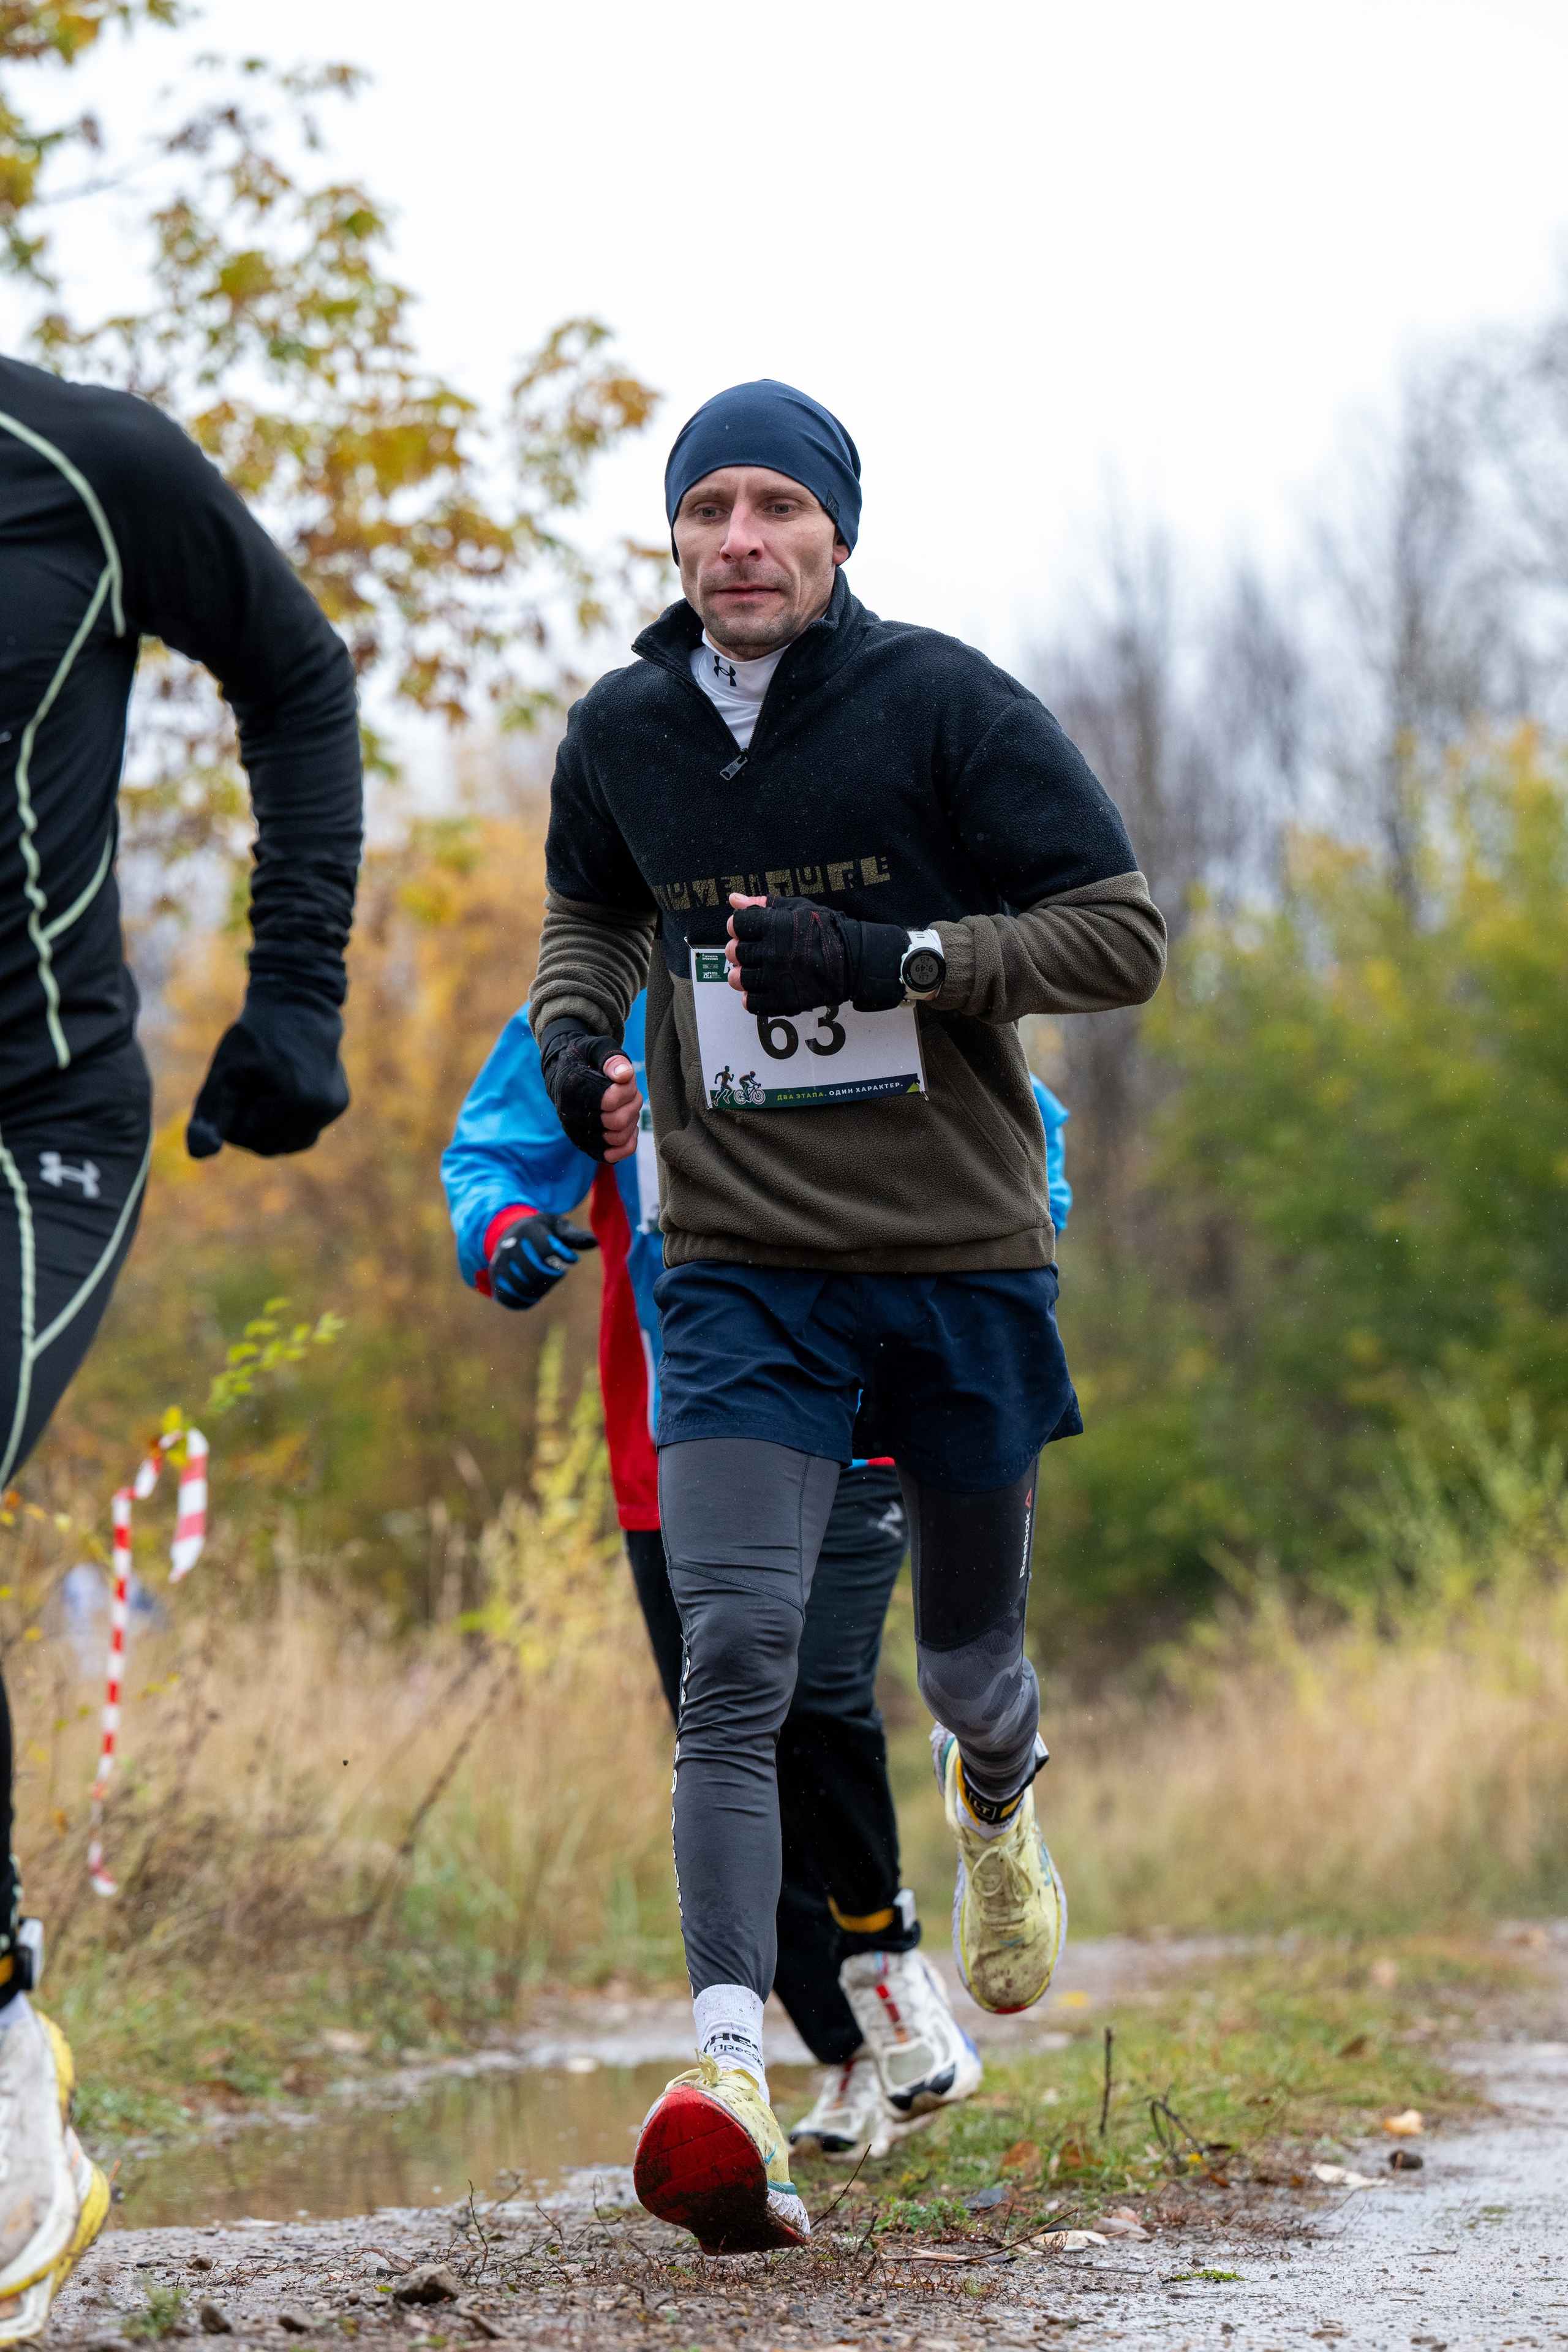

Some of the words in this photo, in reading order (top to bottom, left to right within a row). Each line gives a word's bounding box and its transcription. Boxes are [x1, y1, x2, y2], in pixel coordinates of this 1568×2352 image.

[756, 1005, 846, 1060] 63
[856, 1082, 903, 1093] ХАРАКТЕР.
[1019, 1510, 1031, 1578] Reebok
